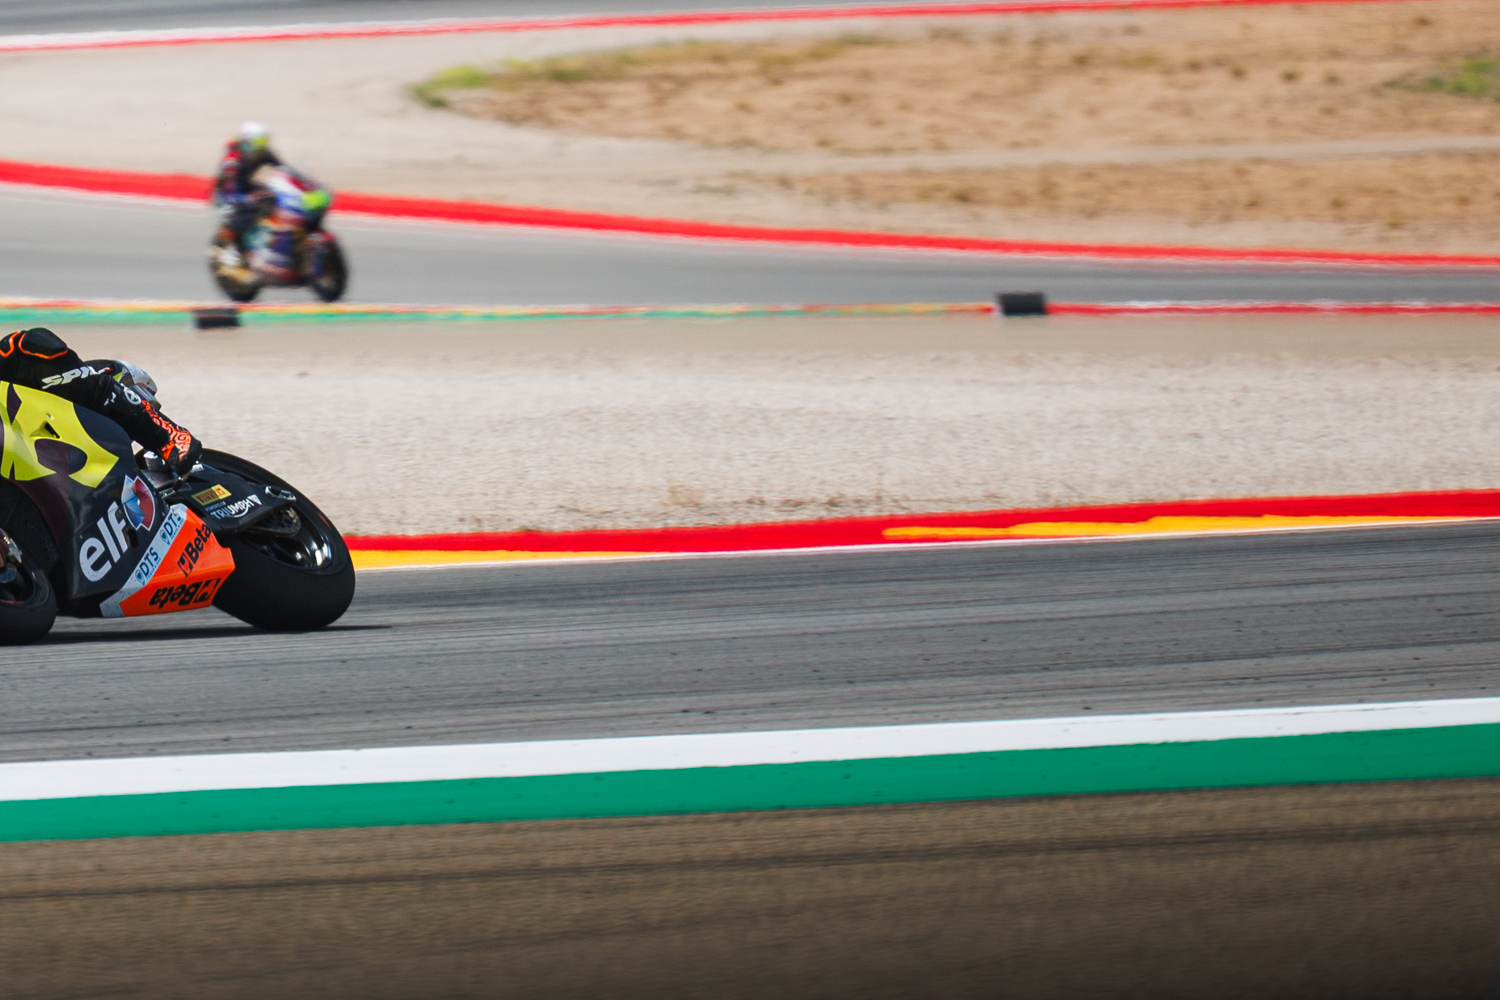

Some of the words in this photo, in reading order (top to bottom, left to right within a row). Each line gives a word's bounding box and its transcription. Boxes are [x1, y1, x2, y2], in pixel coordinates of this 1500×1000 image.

[210, 497, 255, 519] TRIUMPH
[79, 501, 128, 582] elf
[187, 523, 212, 564] Beta
[139, 546, 159, 576] DTS
[149, 580, 198, 609] Beta
